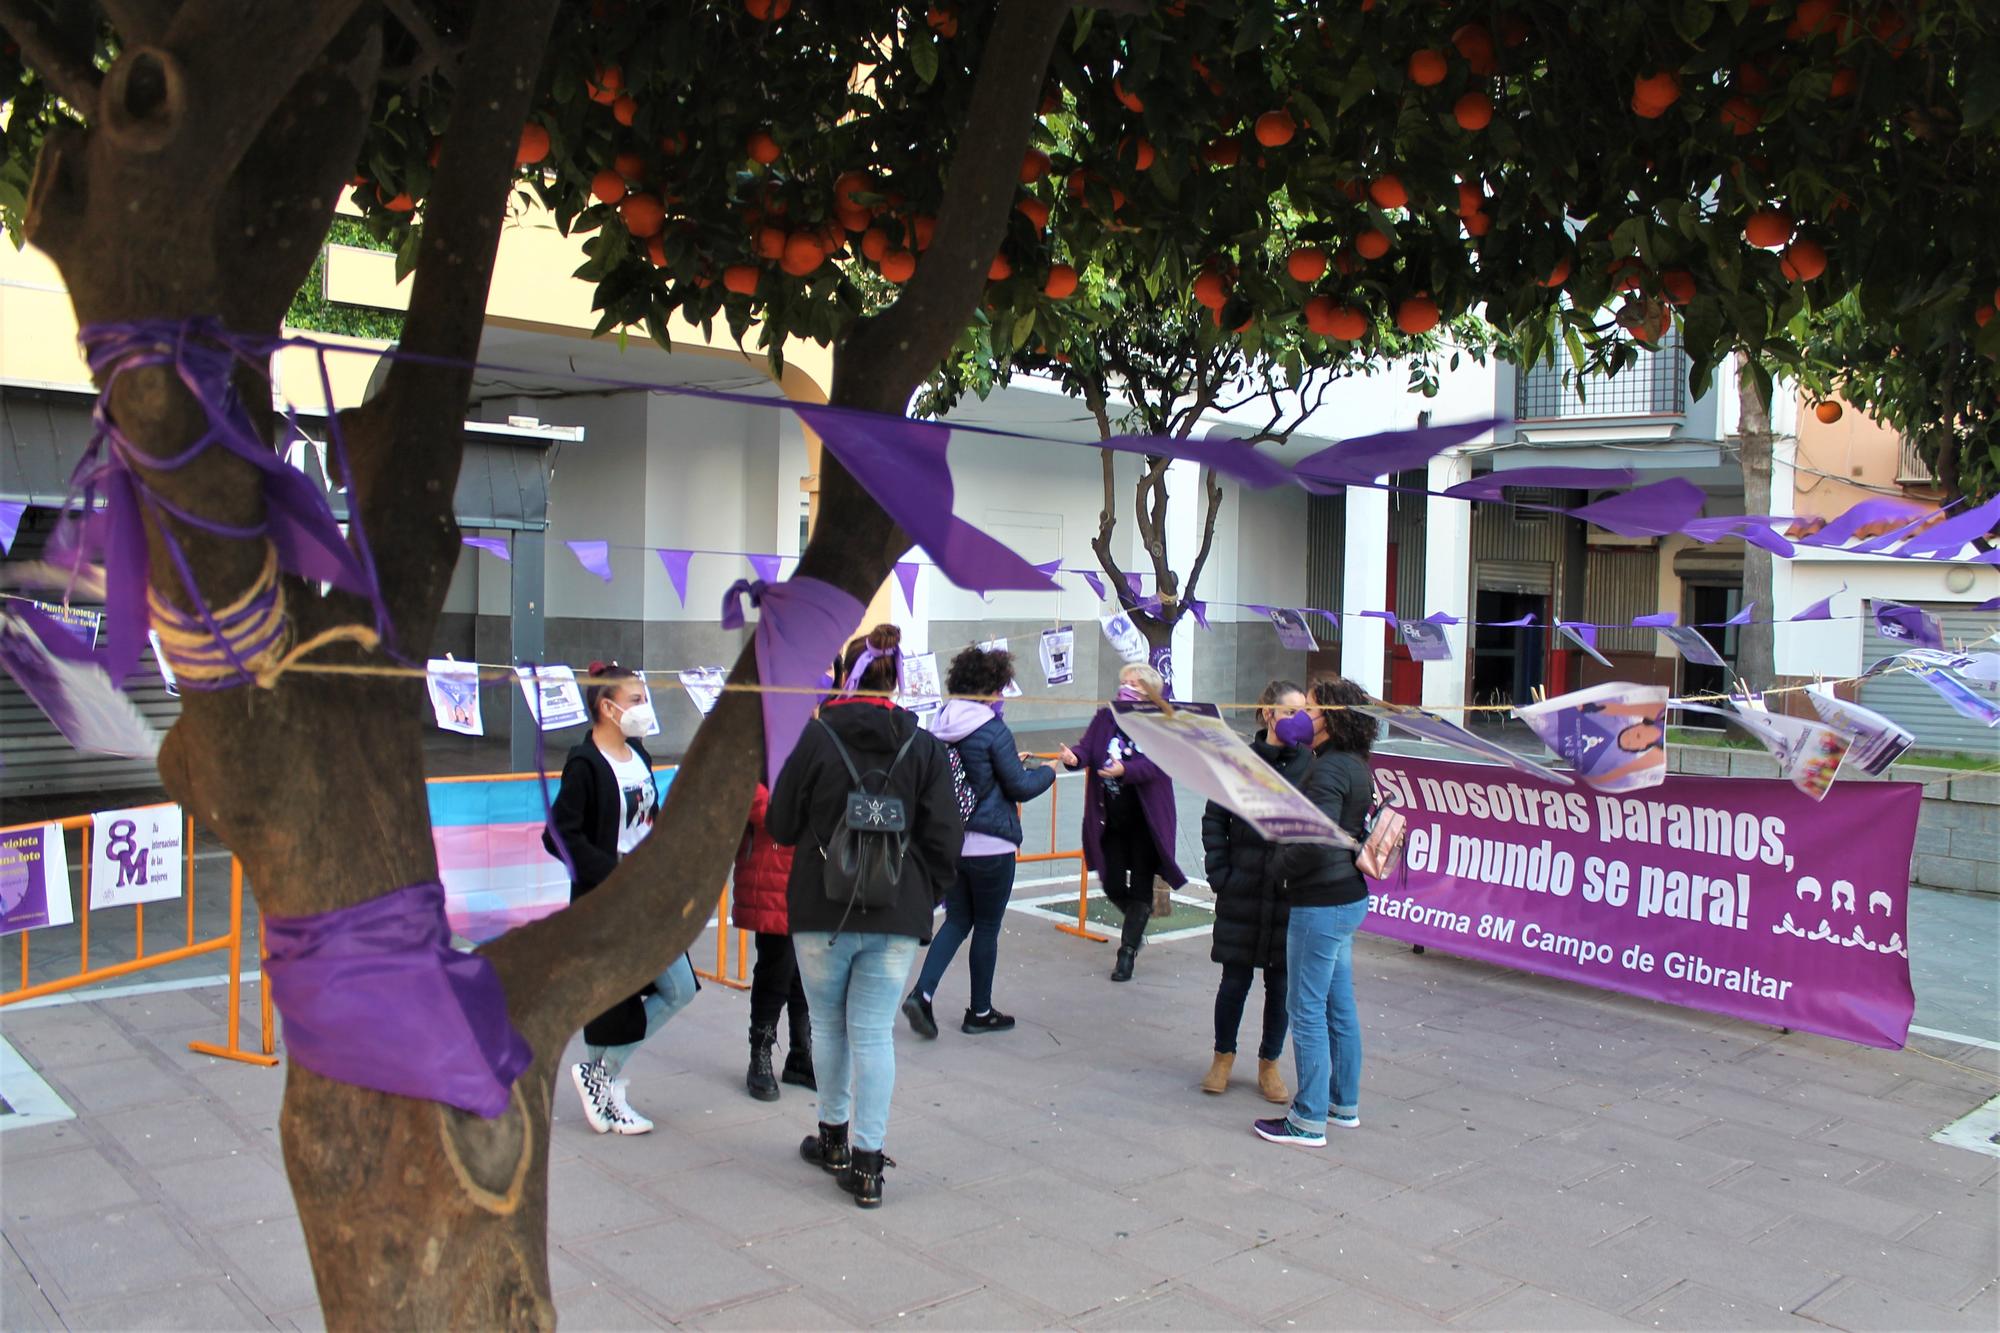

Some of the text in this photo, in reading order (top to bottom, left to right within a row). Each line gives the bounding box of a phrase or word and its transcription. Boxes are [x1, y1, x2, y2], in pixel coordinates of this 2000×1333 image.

[1403, 623, 1421, 638] 8M
[3, 836, 39, 849] violeta
[18, 850, 41, 864] foto
[106, 819, 149, 888] 8M
[1416, 776, 1591, 833] nosotras
[1595, 795, 1794, 873] paramos,
[1406, 823, 1750, 931] el mundo se para!
[1367, 893, 1793, 1001] ataforma 8M Campo de Gibraltar
